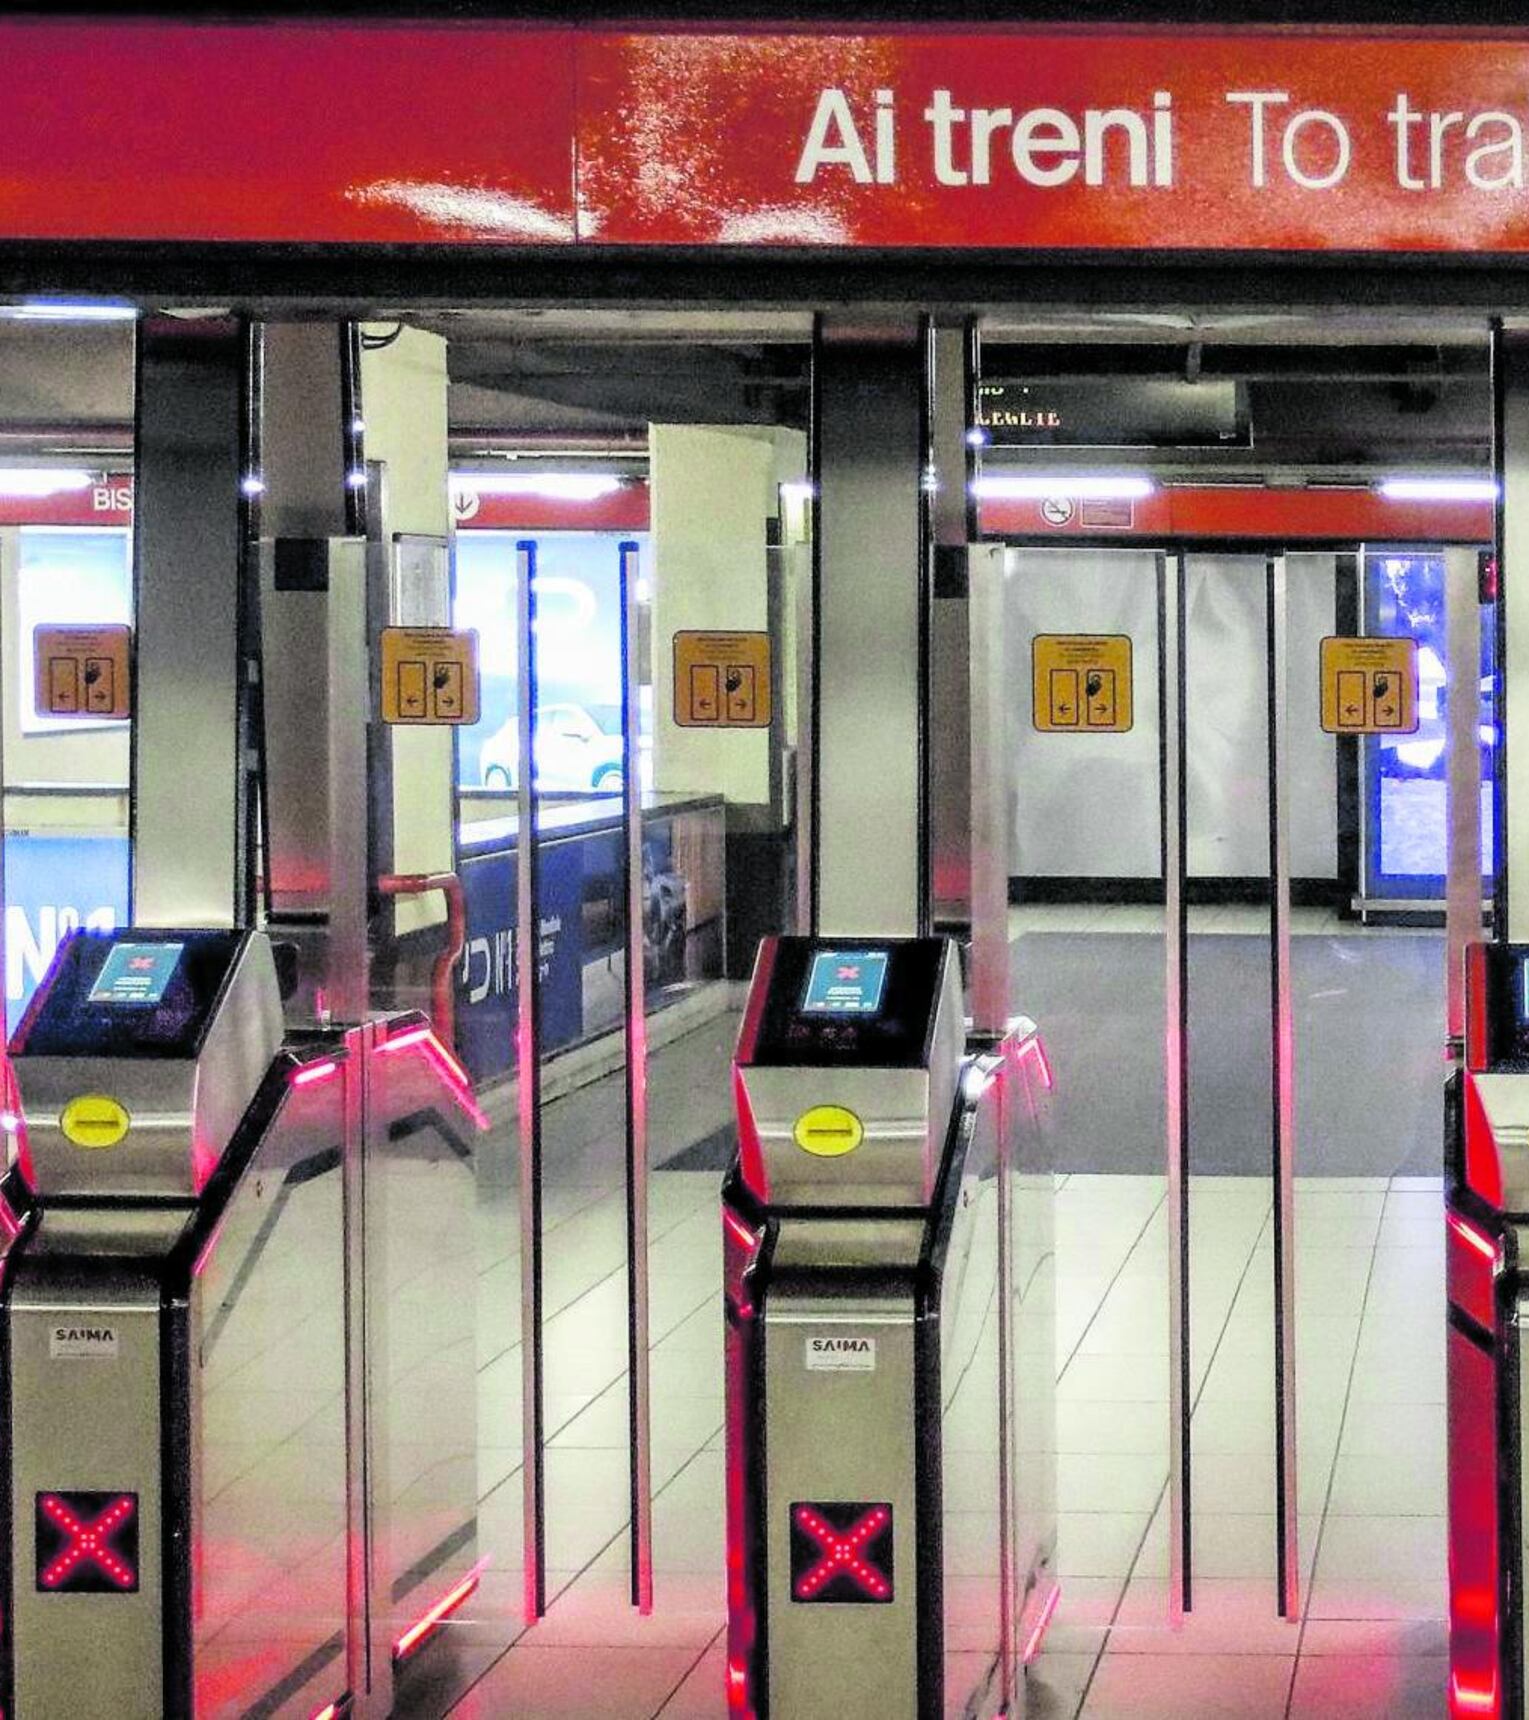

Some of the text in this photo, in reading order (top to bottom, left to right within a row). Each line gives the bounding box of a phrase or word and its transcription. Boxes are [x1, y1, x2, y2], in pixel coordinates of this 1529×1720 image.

[795, 87, 895, 186] Ai
[923, 90, 1173, 190] treni
[1224, 90, 1351, 190] To
[56, 1329, 114, 1342] SAIMA
[813, 1339, 870, 1352] SAIMA
